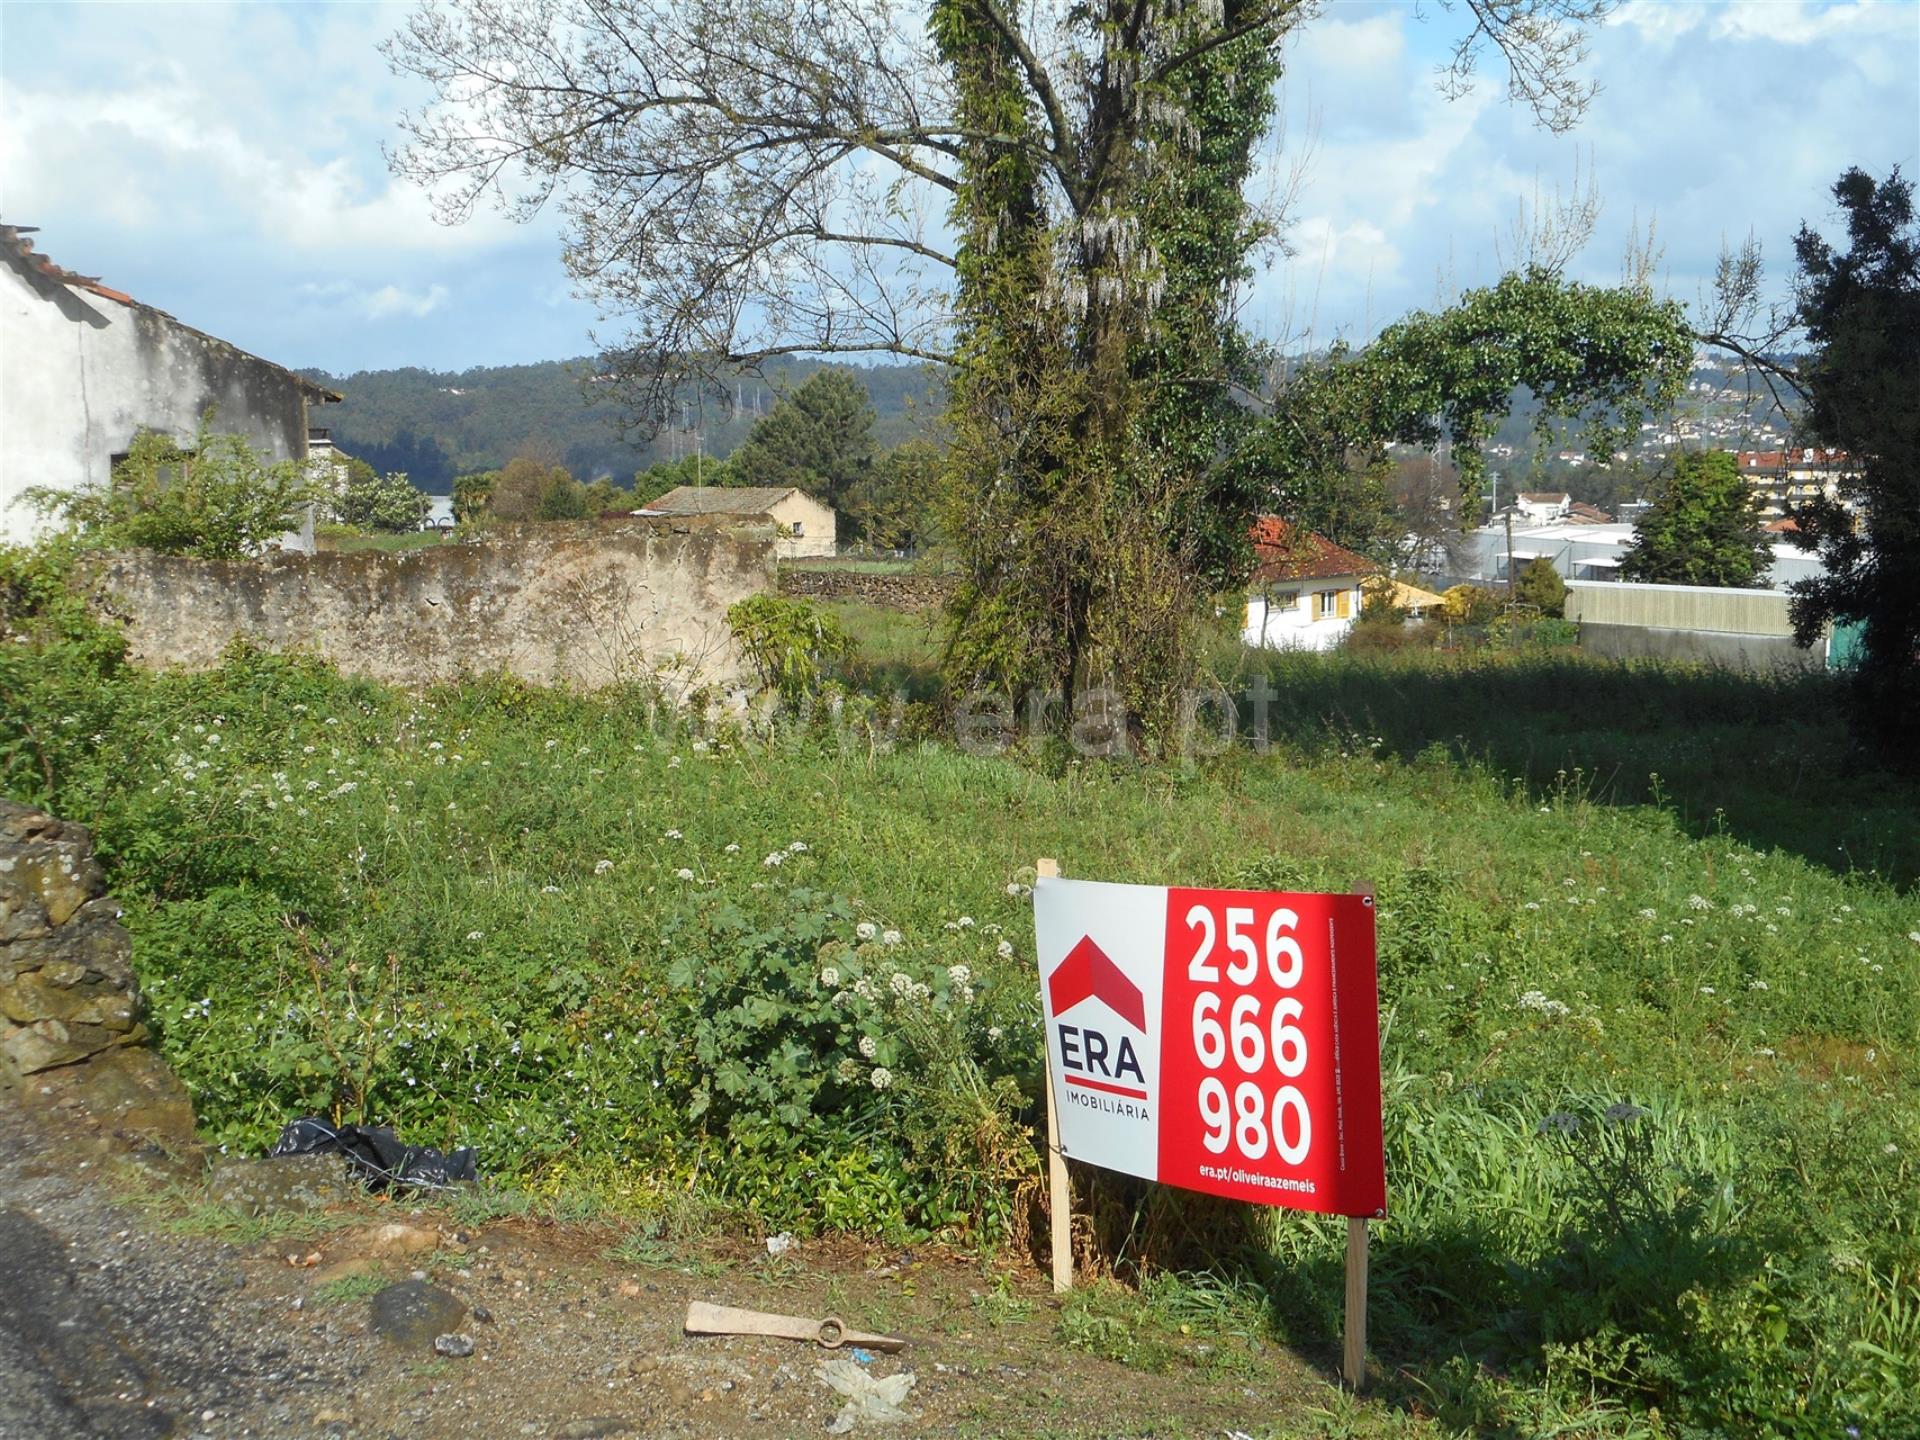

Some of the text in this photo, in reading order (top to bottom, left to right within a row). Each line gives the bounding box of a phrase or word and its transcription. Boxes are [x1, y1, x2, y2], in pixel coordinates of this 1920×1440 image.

[1185, 904, 1303, 989] 256
[1058, 1023, 1145, 1083] ERA
[1192, 991, 1307, 1078] 666
[1066, 1090, 1150, 1121] IMOBILIÁRIA
[1198, 1076, 1311, 1165] 980
[1199, 1164, 1316, 1194] era.pt/oliveiraazemeis
